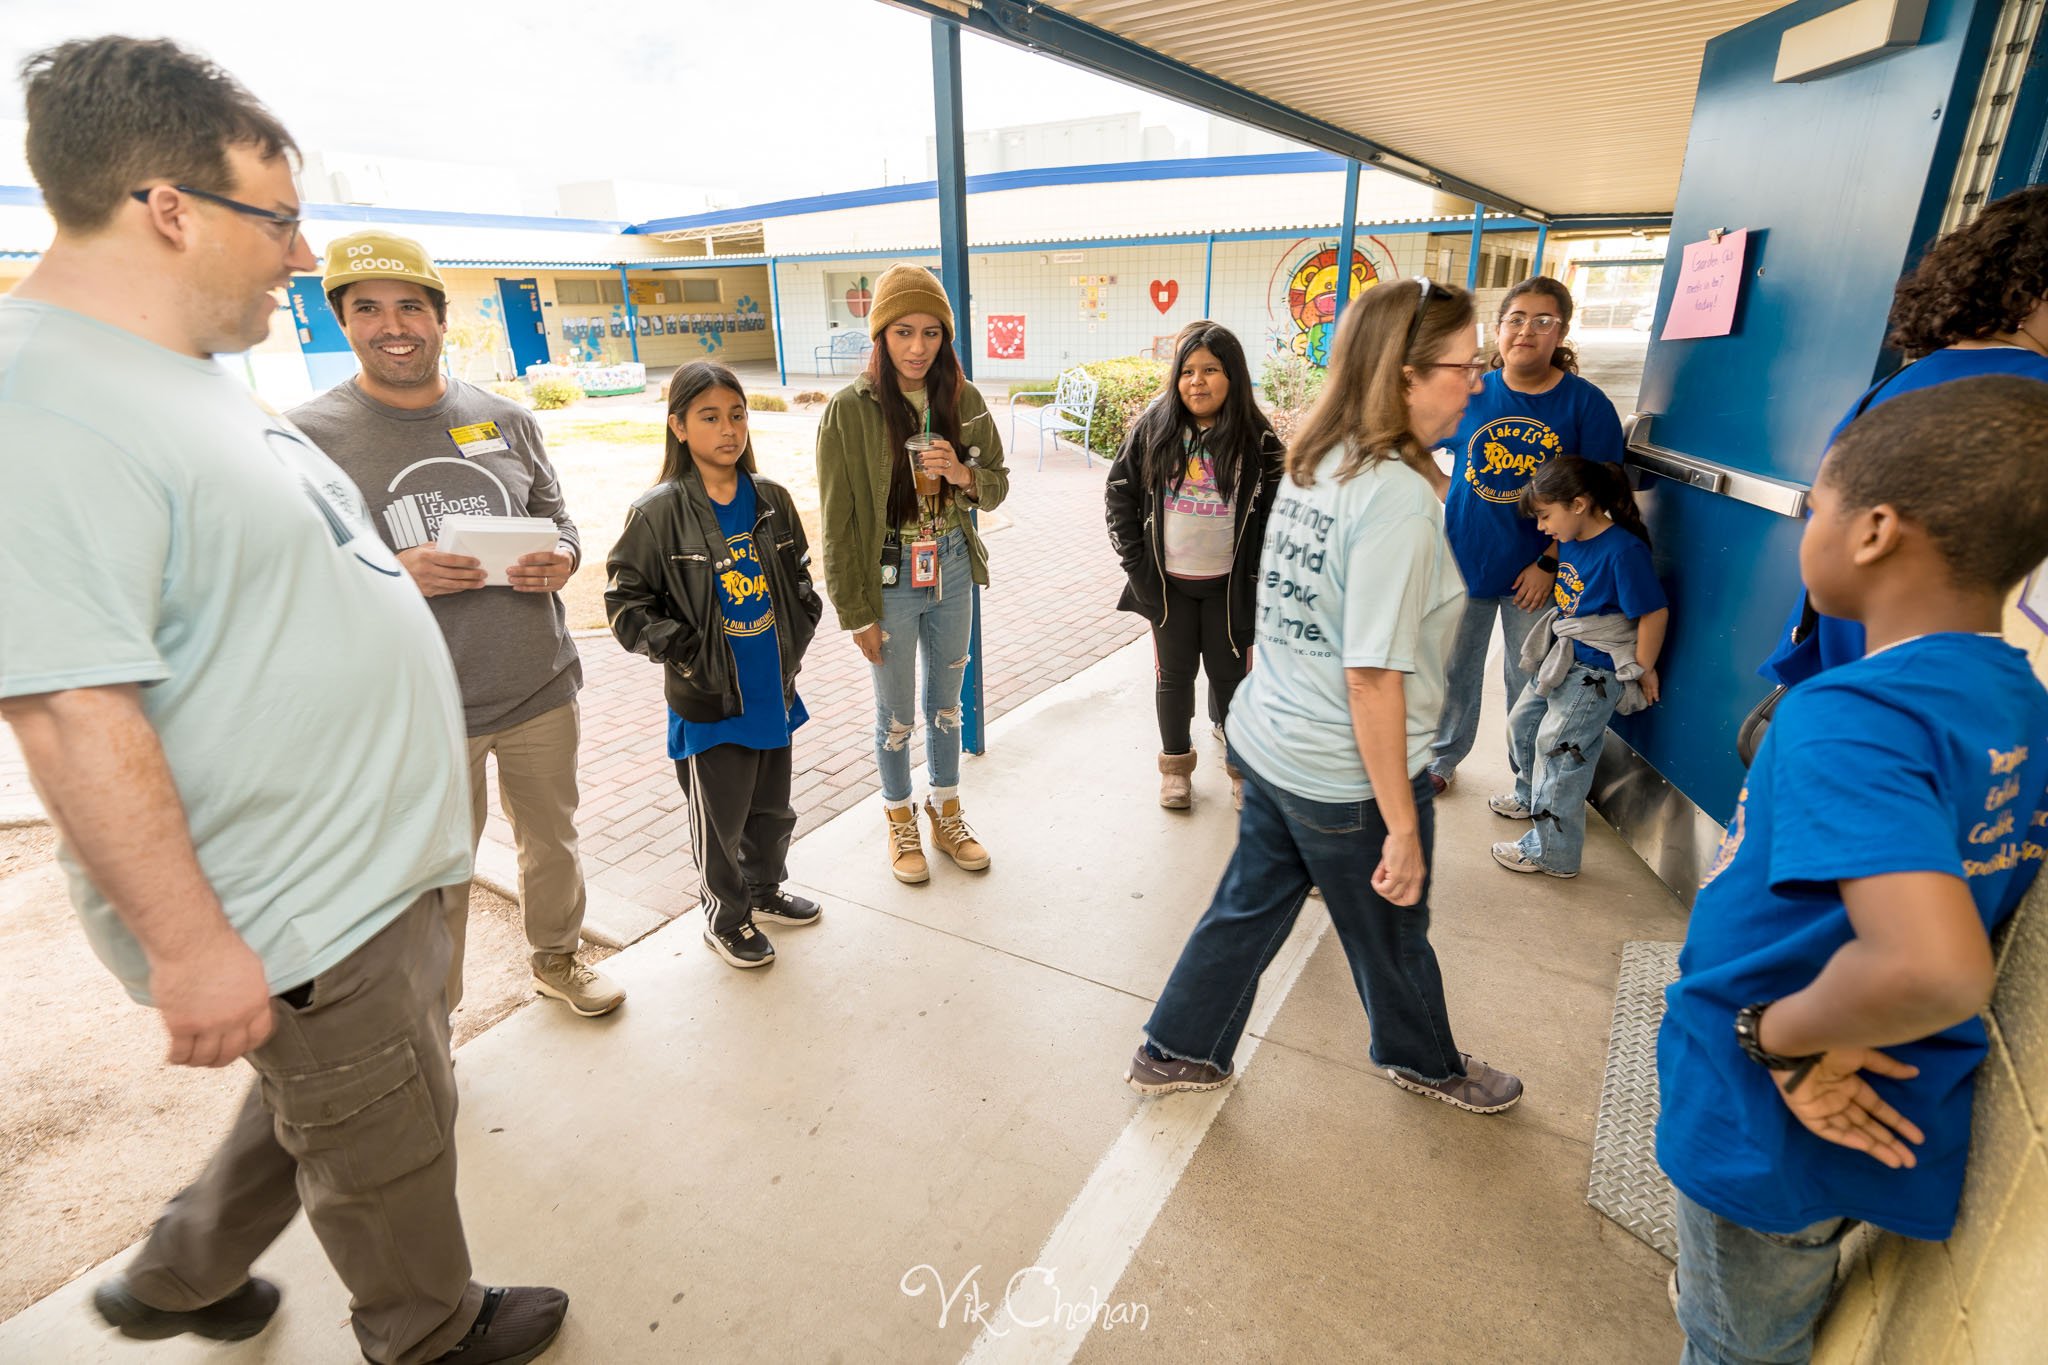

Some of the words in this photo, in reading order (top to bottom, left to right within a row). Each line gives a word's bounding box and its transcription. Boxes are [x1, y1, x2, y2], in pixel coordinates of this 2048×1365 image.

[347, 244, 373, 258] DO
[350, 258, 410, 273] GOOD.
[1488, 425, 1521, 441] Lake
[1521, 427, 1542, 444] ES
[1491, 447, 1538, 472] ROAR
[415, 491, 444, 505] THE
[421, 495, 488, 517] LEADERS
